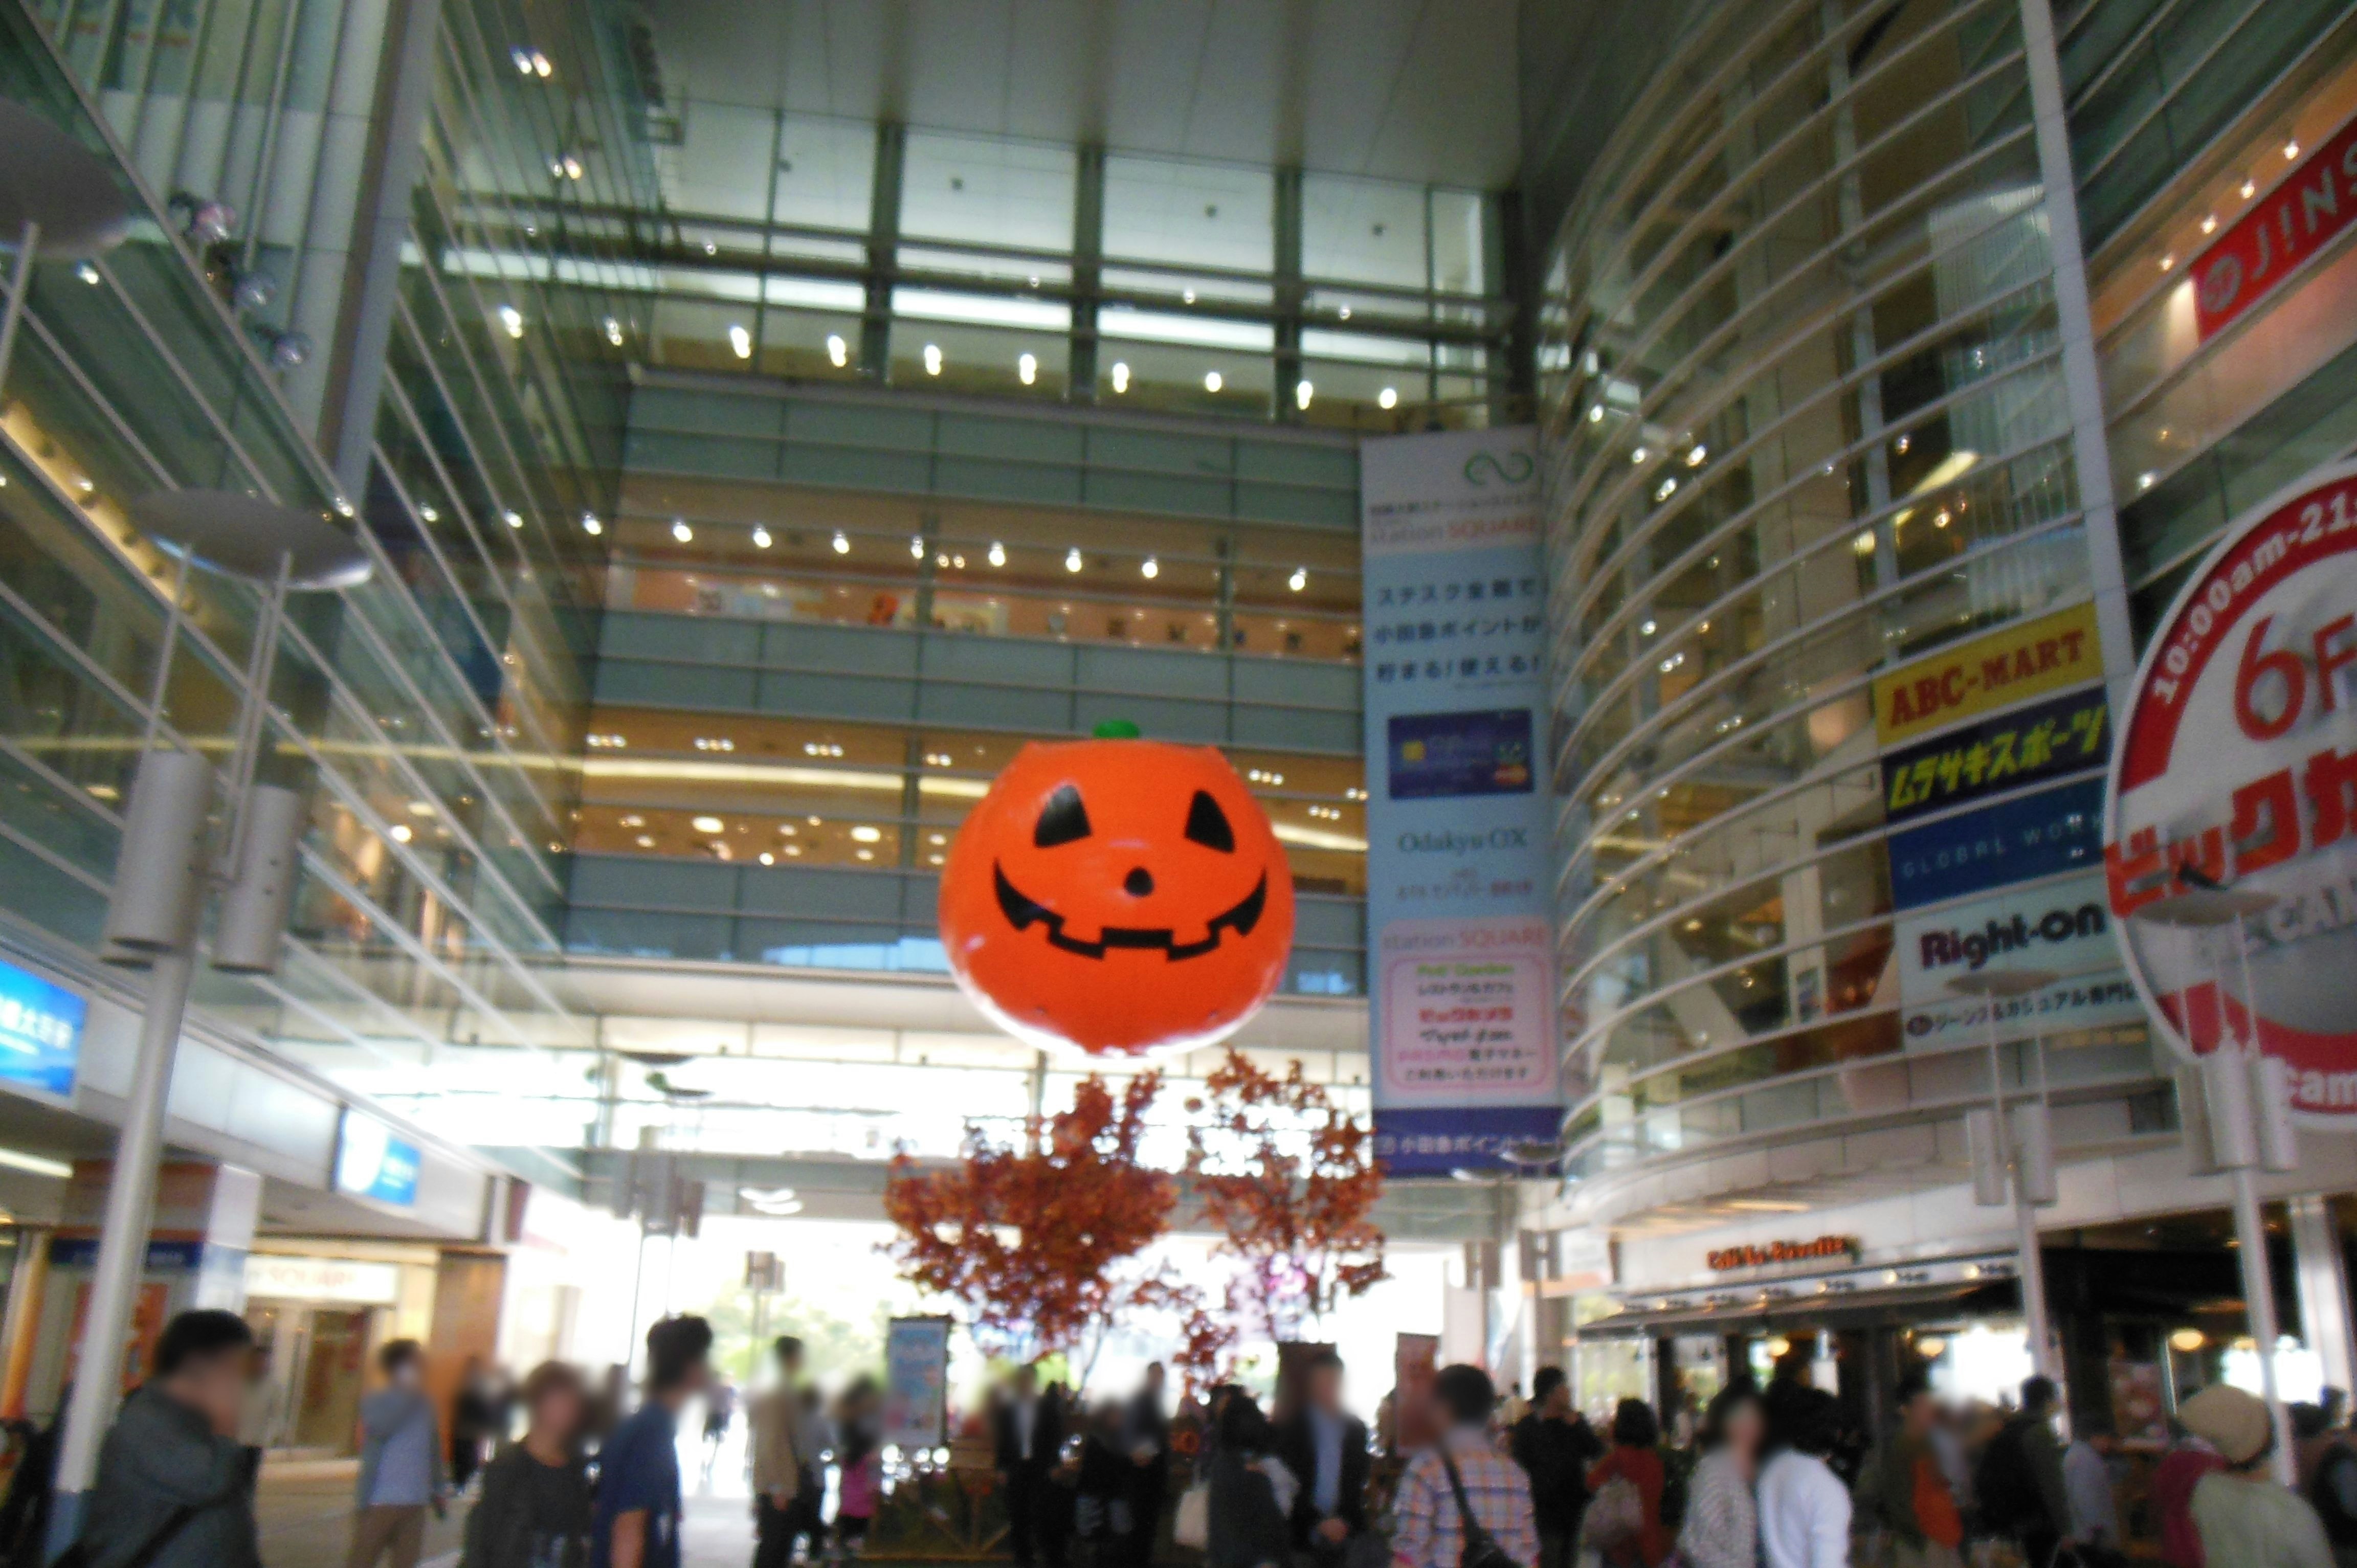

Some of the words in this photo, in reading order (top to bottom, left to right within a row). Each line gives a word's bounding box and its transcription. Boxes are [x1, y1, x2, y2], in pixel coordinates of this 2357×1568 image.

[1890, 627, 2085, 728] ABC-MART
[1889, 703, 2107, 811] ムラサキスポーツ
[1397, 830, 1483, 857] Odakyu
[1489, 827, 1528, 850] OX
[1460, 927, 1546, 948] SQUARE
[1920, 903, 2106, 970] Right-on
